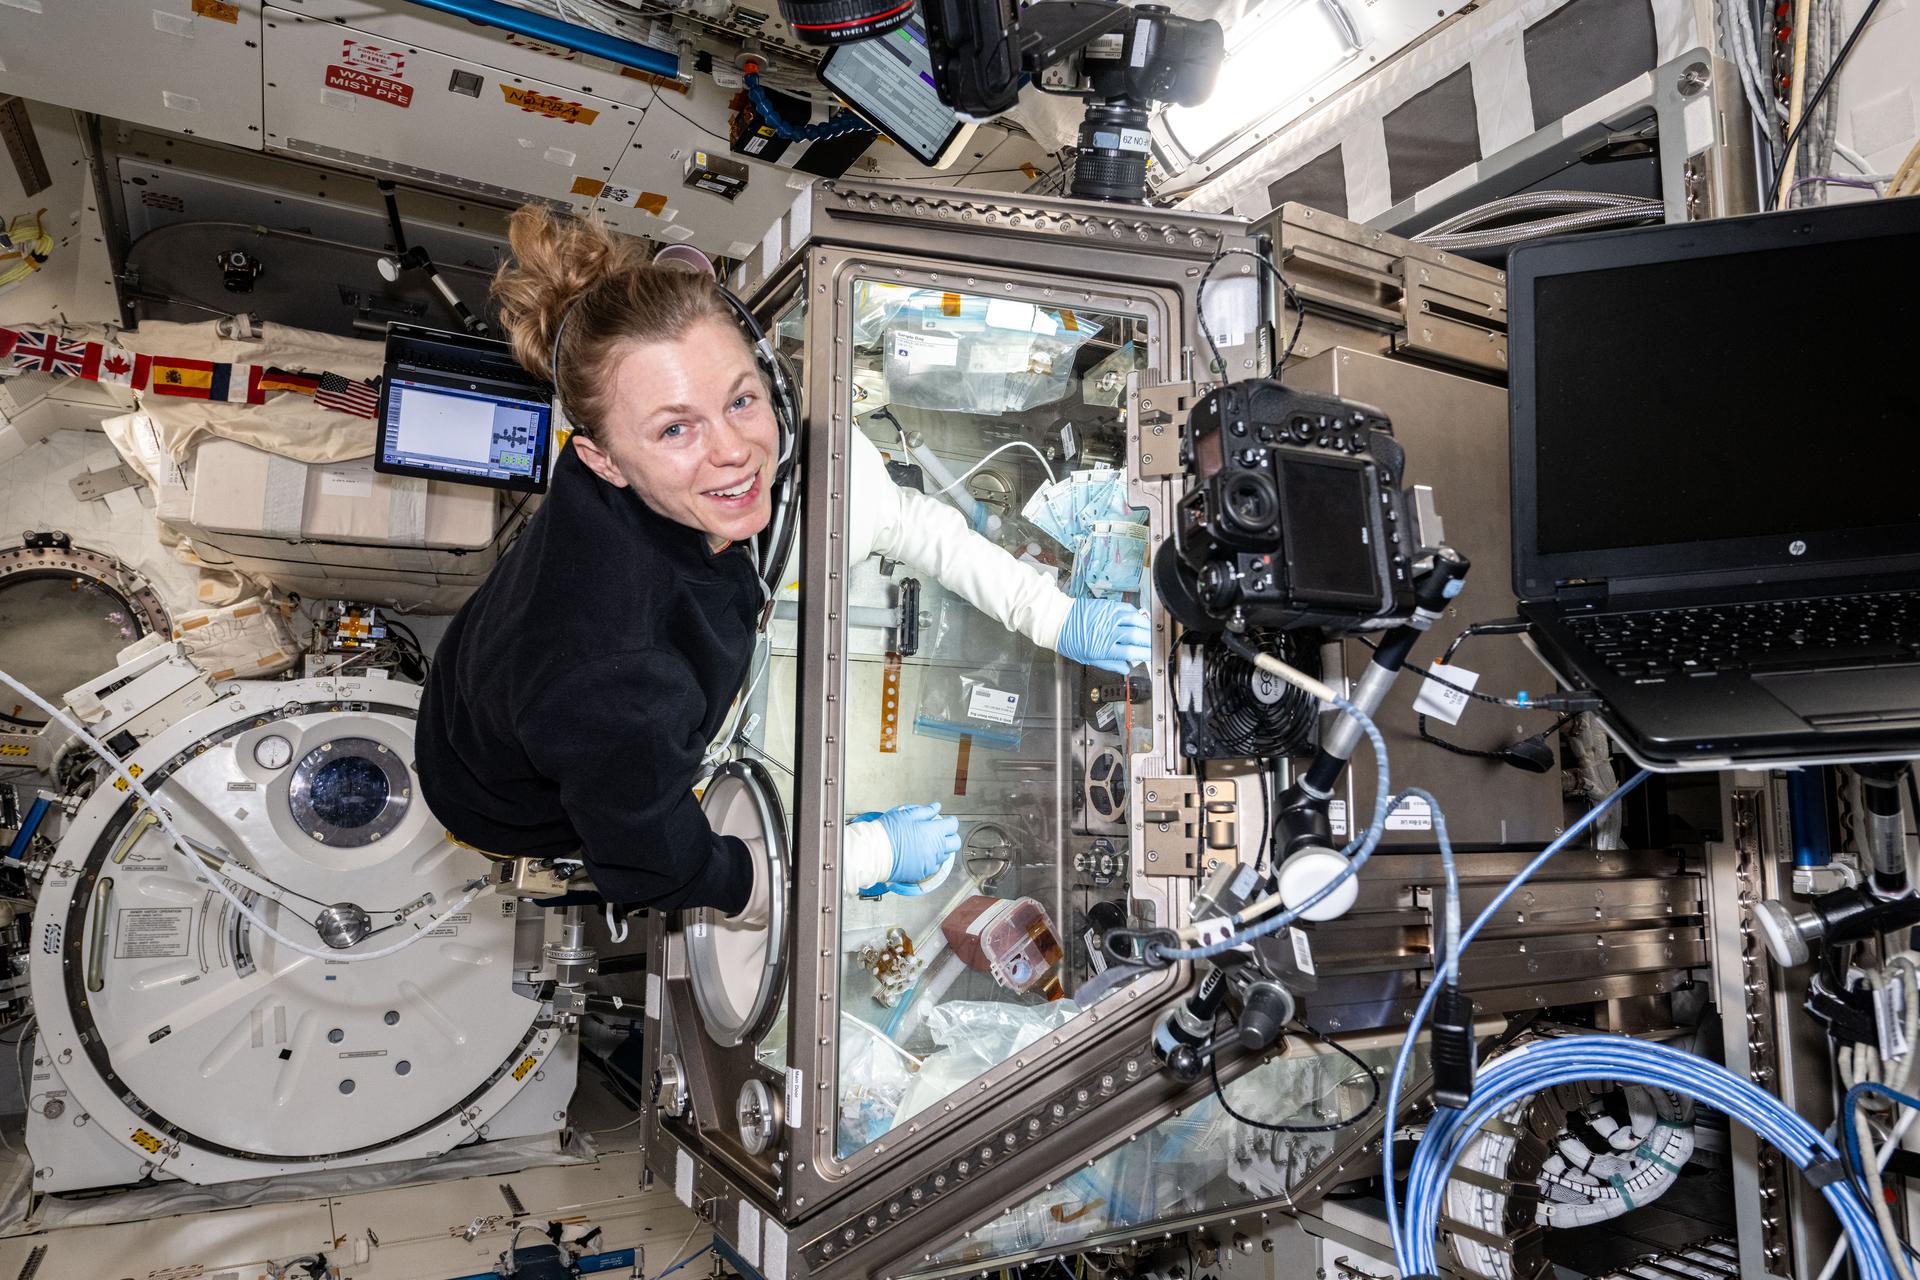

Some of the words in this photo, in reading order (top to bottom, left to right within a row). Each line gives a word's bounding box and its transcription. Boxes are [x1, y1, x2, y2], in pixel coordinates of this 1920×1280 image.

[360, 54, 388, 64] FIRE
[330, 76, 372, 92] MIST
[376, 88, 408, 104] PFE
[339, 69, 403, 94] WATER
